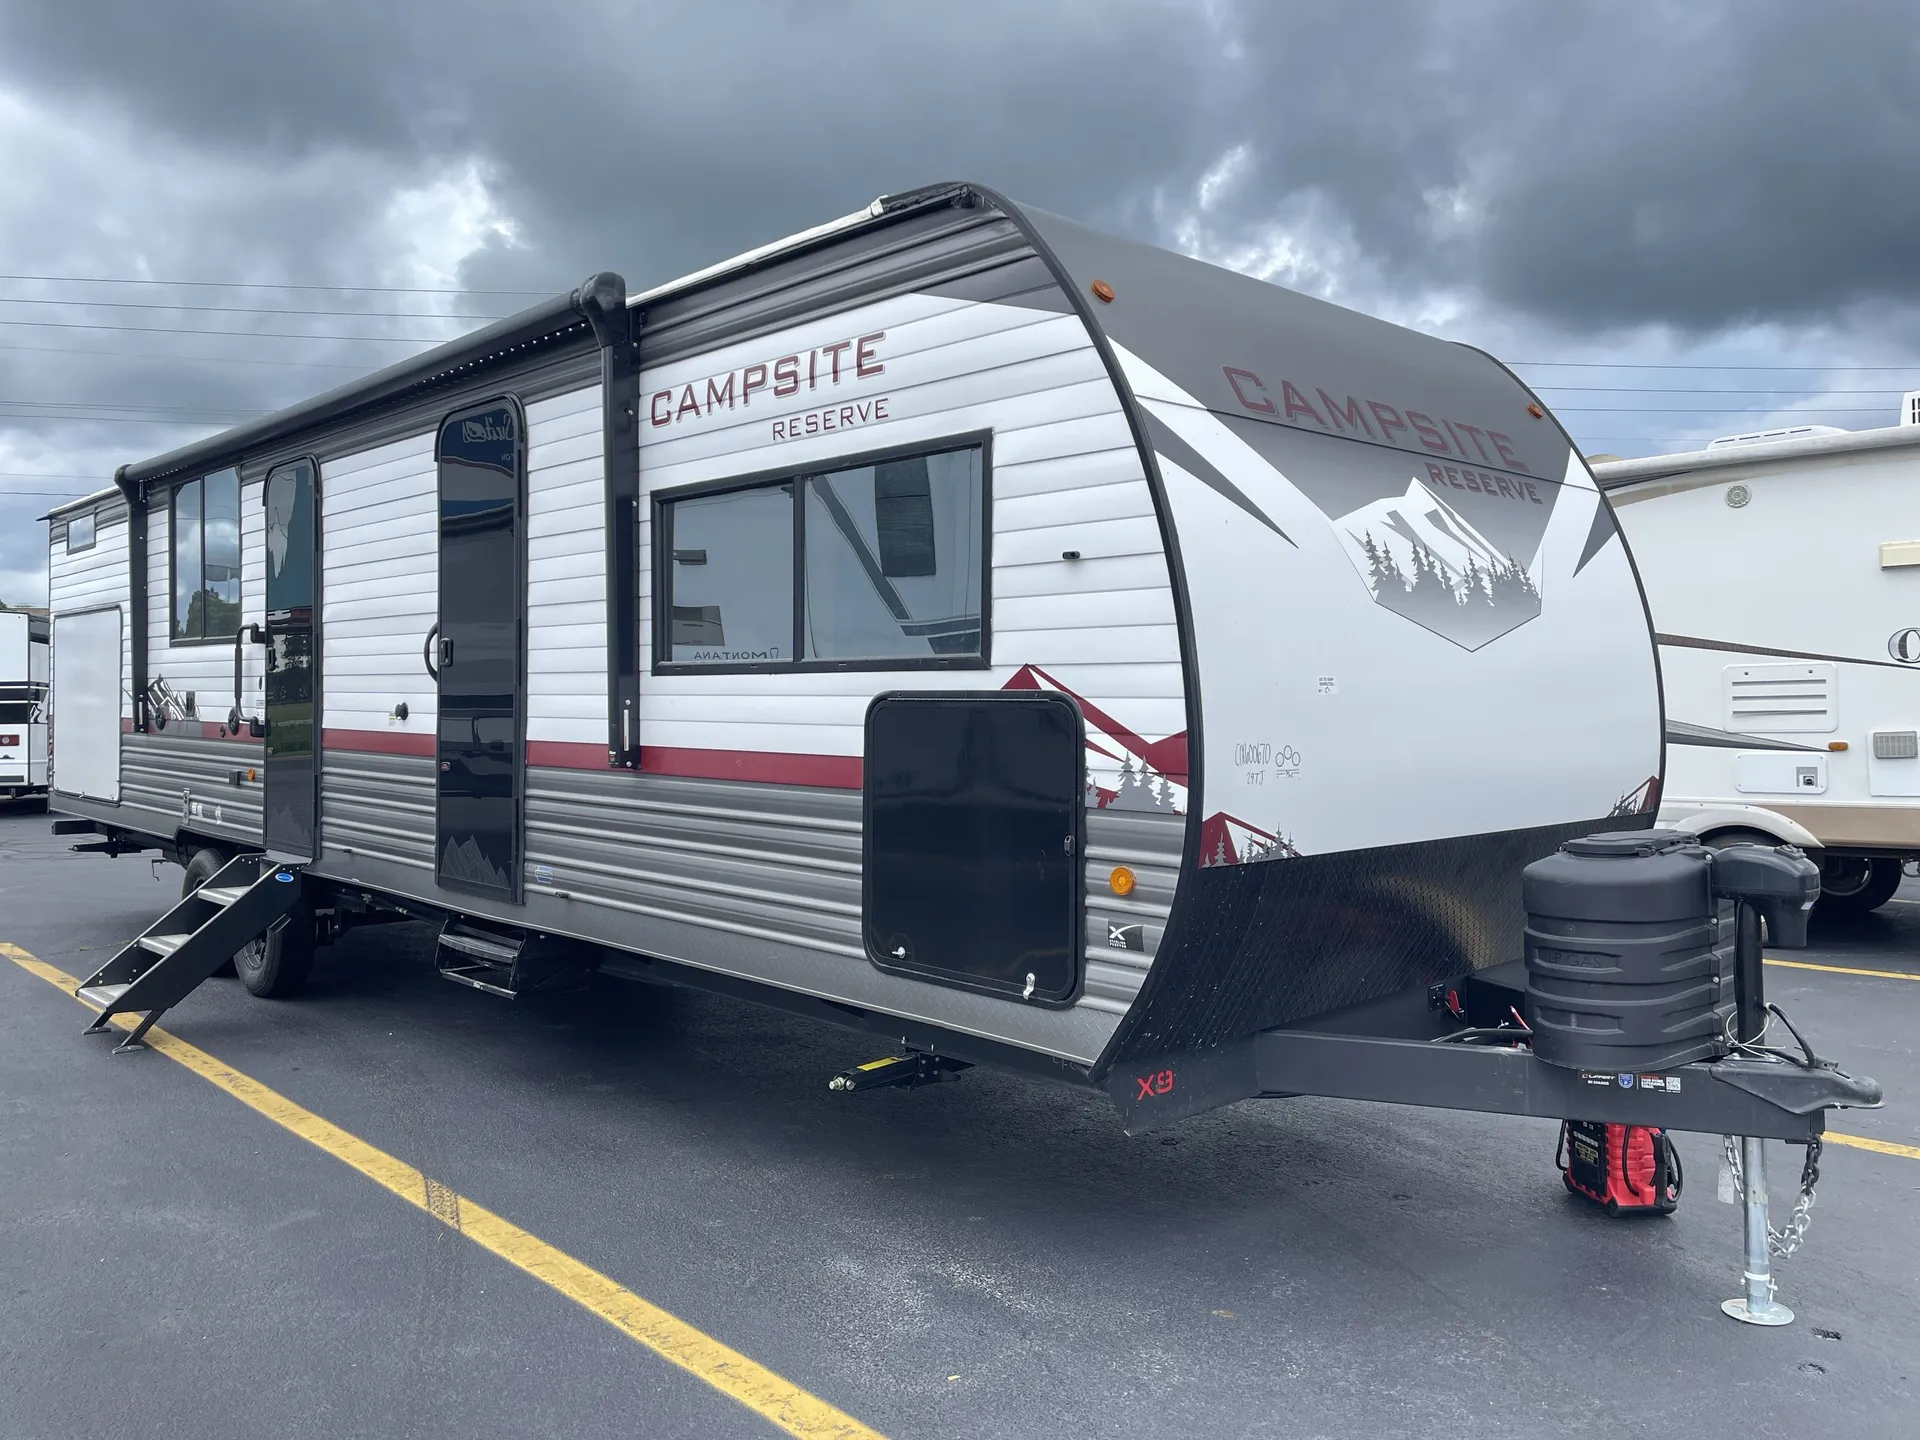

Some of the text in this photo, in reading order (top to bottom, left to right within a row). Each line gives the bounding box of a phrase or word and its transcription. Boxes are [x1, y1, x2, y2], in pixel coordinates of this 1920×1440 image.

[651, 331, 885, 427] CAMPSITE
[772, 398, 889, 441] RESERVE
[1222, 366, 1530, 473] CAMPSITE
[1424, 462, 1543, 505] RESERVE
[1548, 951, 1602, 968] LP GAS
